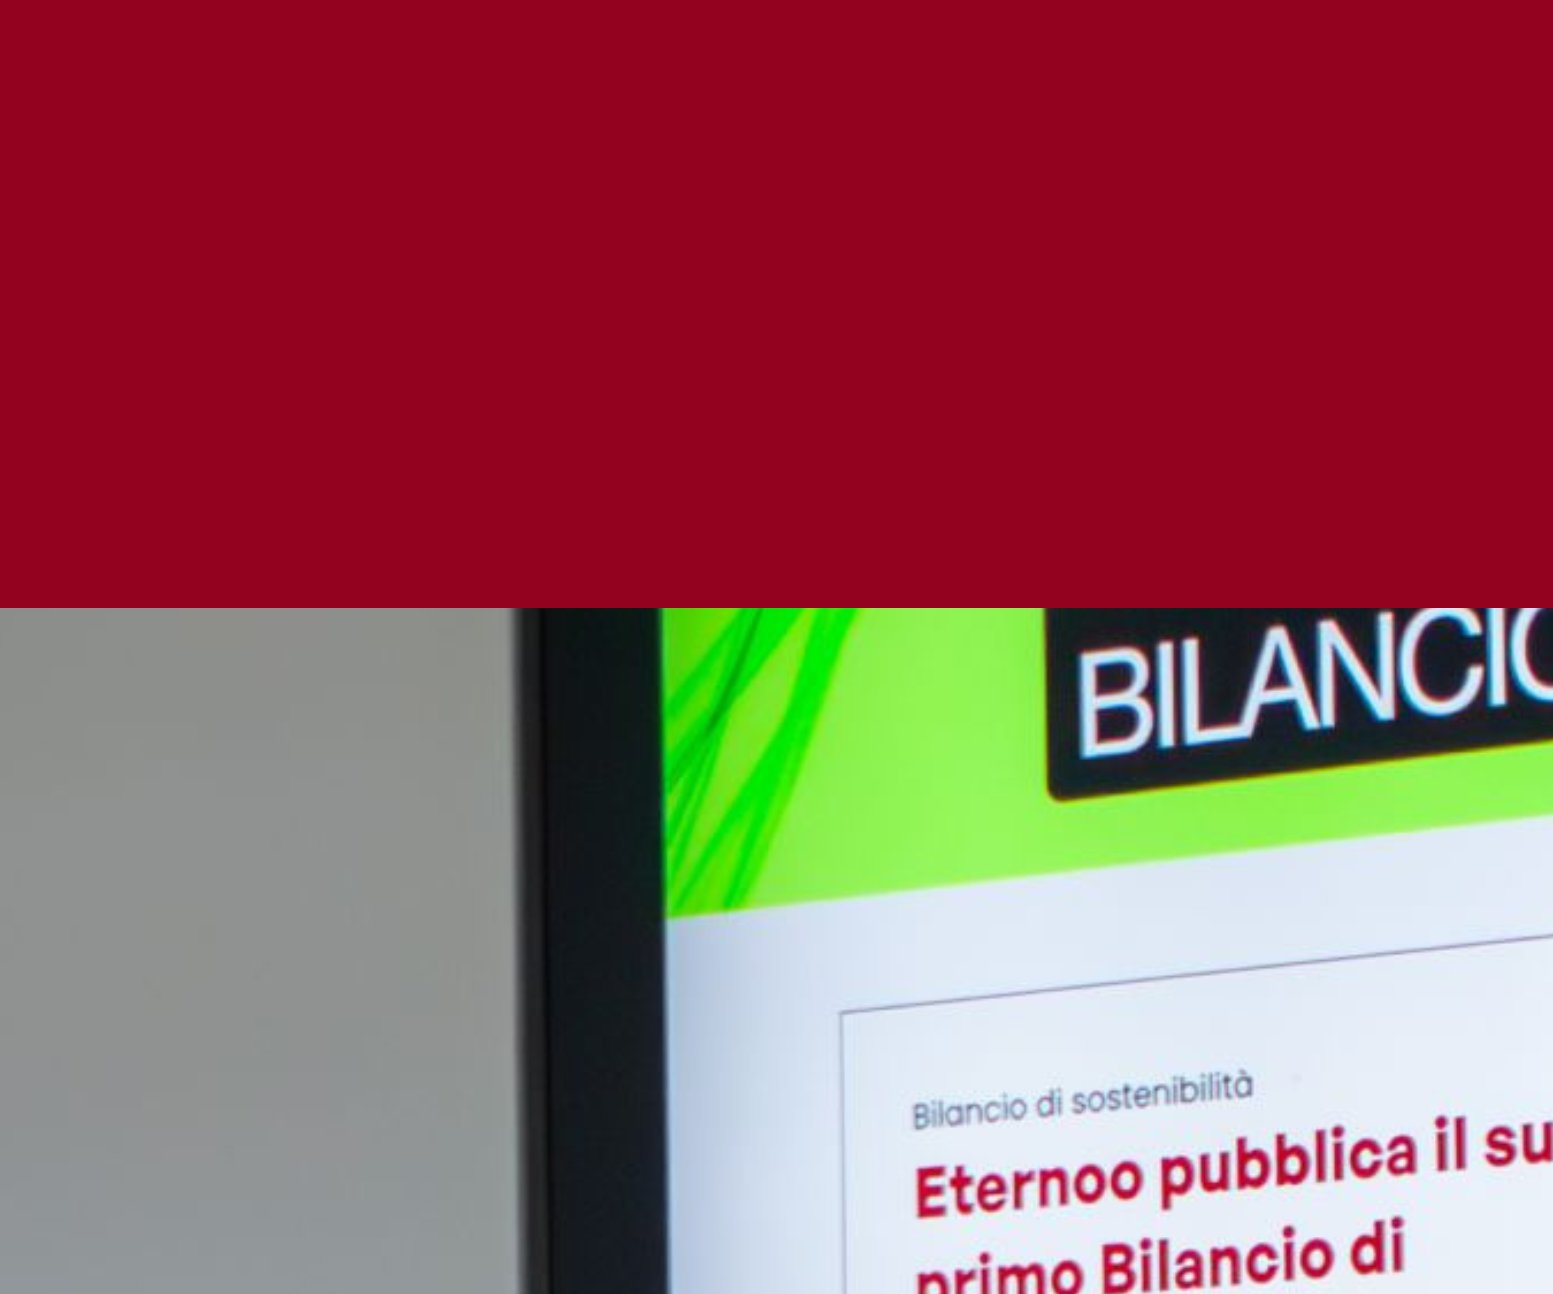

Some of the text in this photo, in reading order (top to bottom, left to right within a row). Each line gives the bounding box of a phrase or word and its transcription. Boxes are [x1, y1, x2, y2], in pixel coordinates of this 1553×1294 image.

[913, 1070, 1254, 1130] Bilancio di sostenibilità
[916, 1115, 1553, 1219] Eternoo pubblica il su
[1351, 1216, 1404, 1275] di
